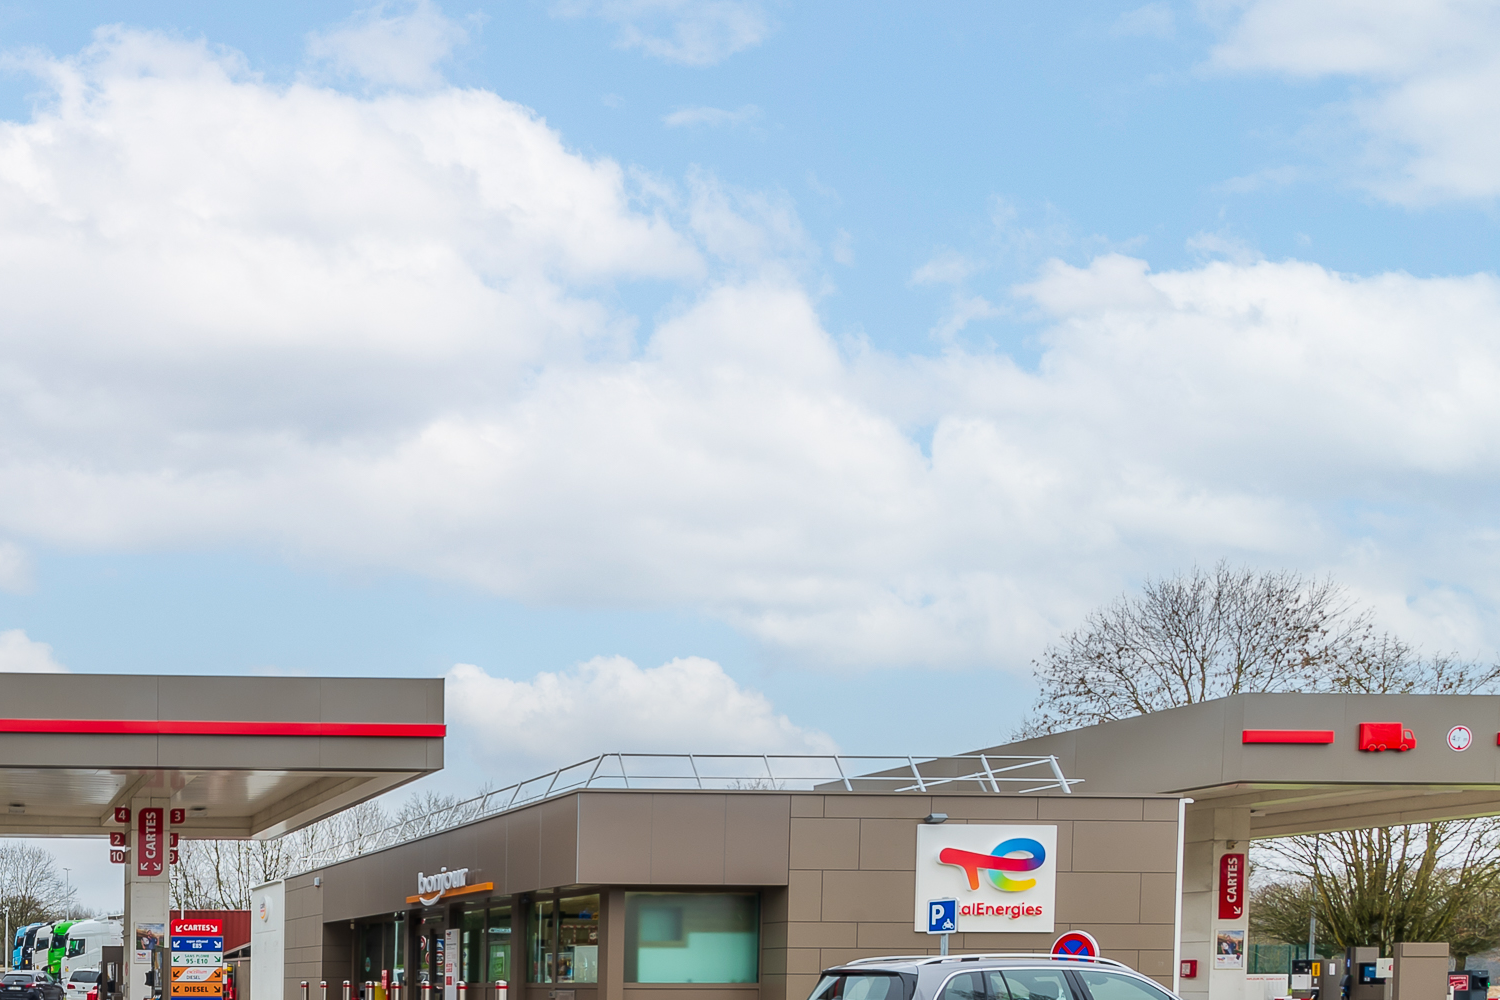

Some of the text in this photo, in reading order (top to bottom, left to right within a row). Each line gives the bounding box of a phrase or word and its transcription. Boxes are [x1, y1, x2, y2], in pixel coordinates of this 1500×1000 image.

[118, 809, 126, 820] 4
[174, 811, 181, 822] 3
[113, 834, 121, 845] 2
[145, 811, 156, 859] CARTES
[111, 851, 124, 862] 10
[169, 852, 175, 862] 9
[1226, 857, 1238, 903] CARTES
[417, 867, 469, 905] bonjour
[931, 904, 945, 926] P
